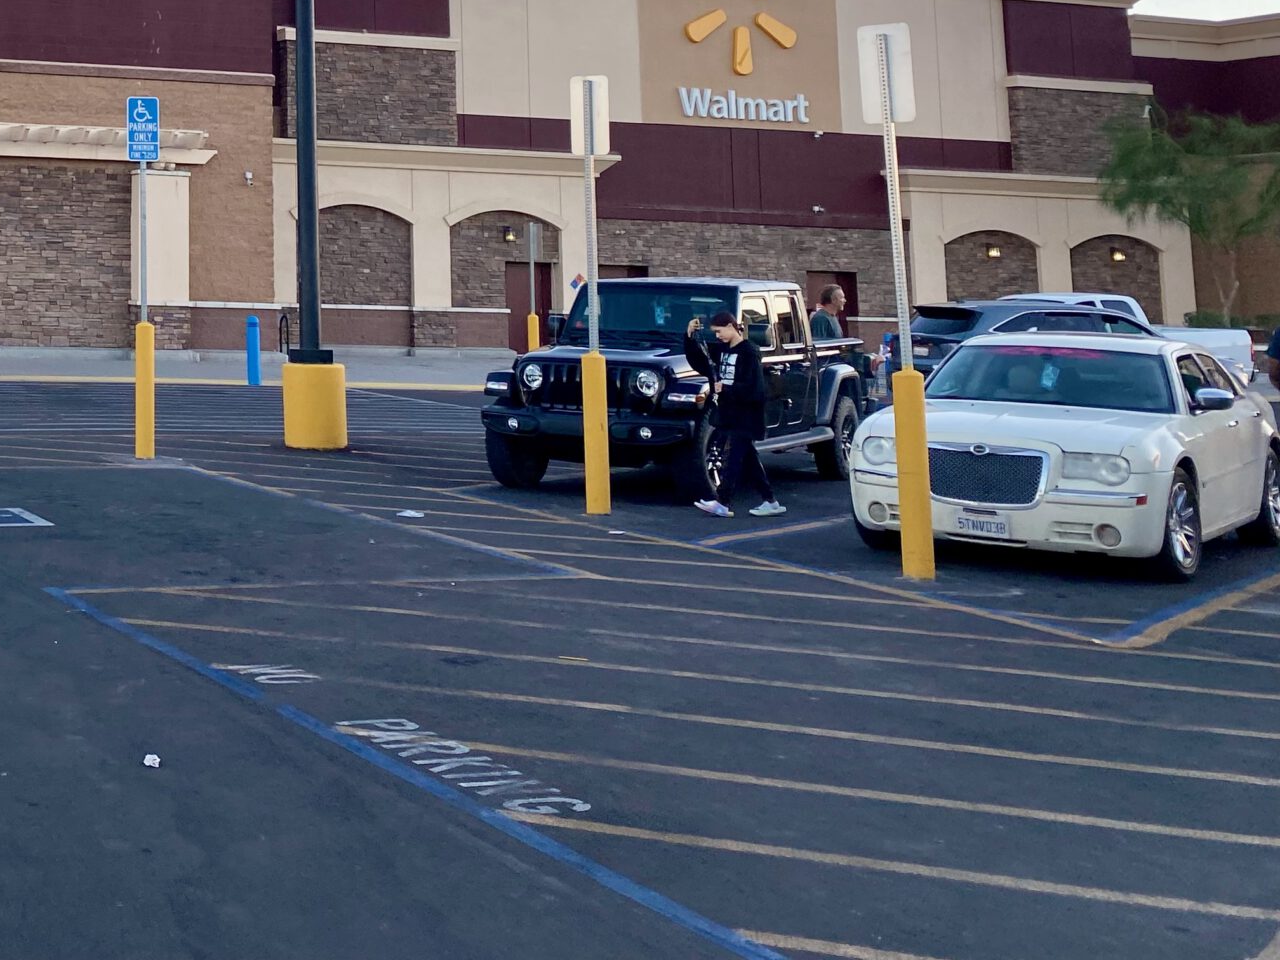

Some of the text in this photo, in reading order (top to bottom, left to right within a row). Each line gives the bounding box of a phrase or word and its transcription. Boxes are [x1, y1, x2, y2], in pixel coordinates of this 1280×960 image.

[678, 87, 810, 123] Walmart
[130, 123, 157, 131] PARKING
[134, 133, 152, 141] ONLY
[335, 718, 591, 814] PARKING
